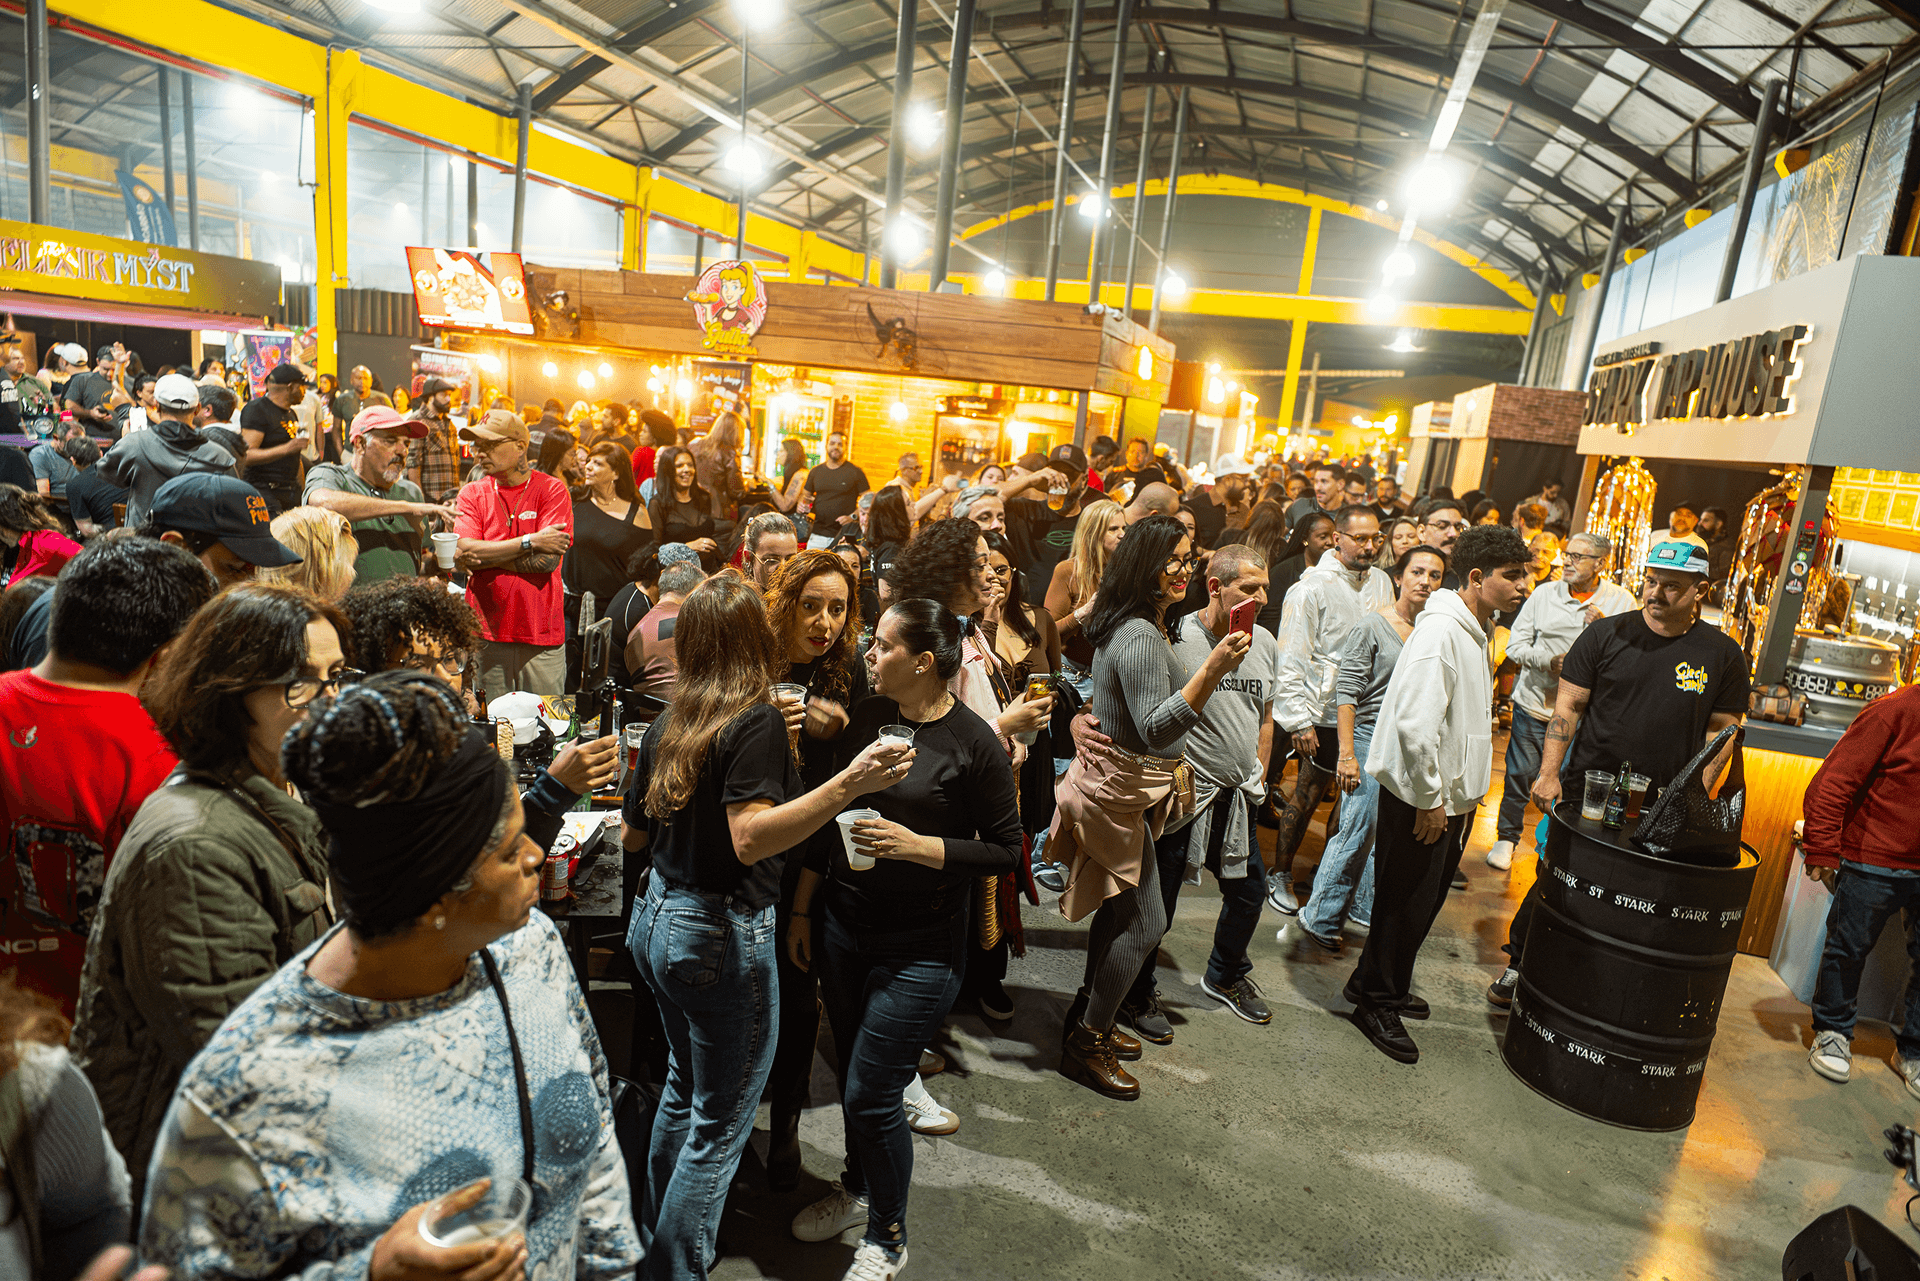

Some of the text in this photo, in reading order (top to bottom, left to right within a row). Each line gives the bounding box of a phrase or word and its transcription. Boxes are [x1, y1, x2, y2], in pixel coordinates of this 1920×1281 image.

[113, 250, 195, 293] MYST
[1582, 358, 1656, 434] STARK
[1553, 866, 1578, 889] STARK
[1589, 885, 1604, 899] ST
[1614, 894, 1656, 914] STARK
[1528, 1018, 1555, 1044] STARK
[1567, 1042, 1606, 1066] STARK
[1641, 1064, 1677, 1078] STARK
